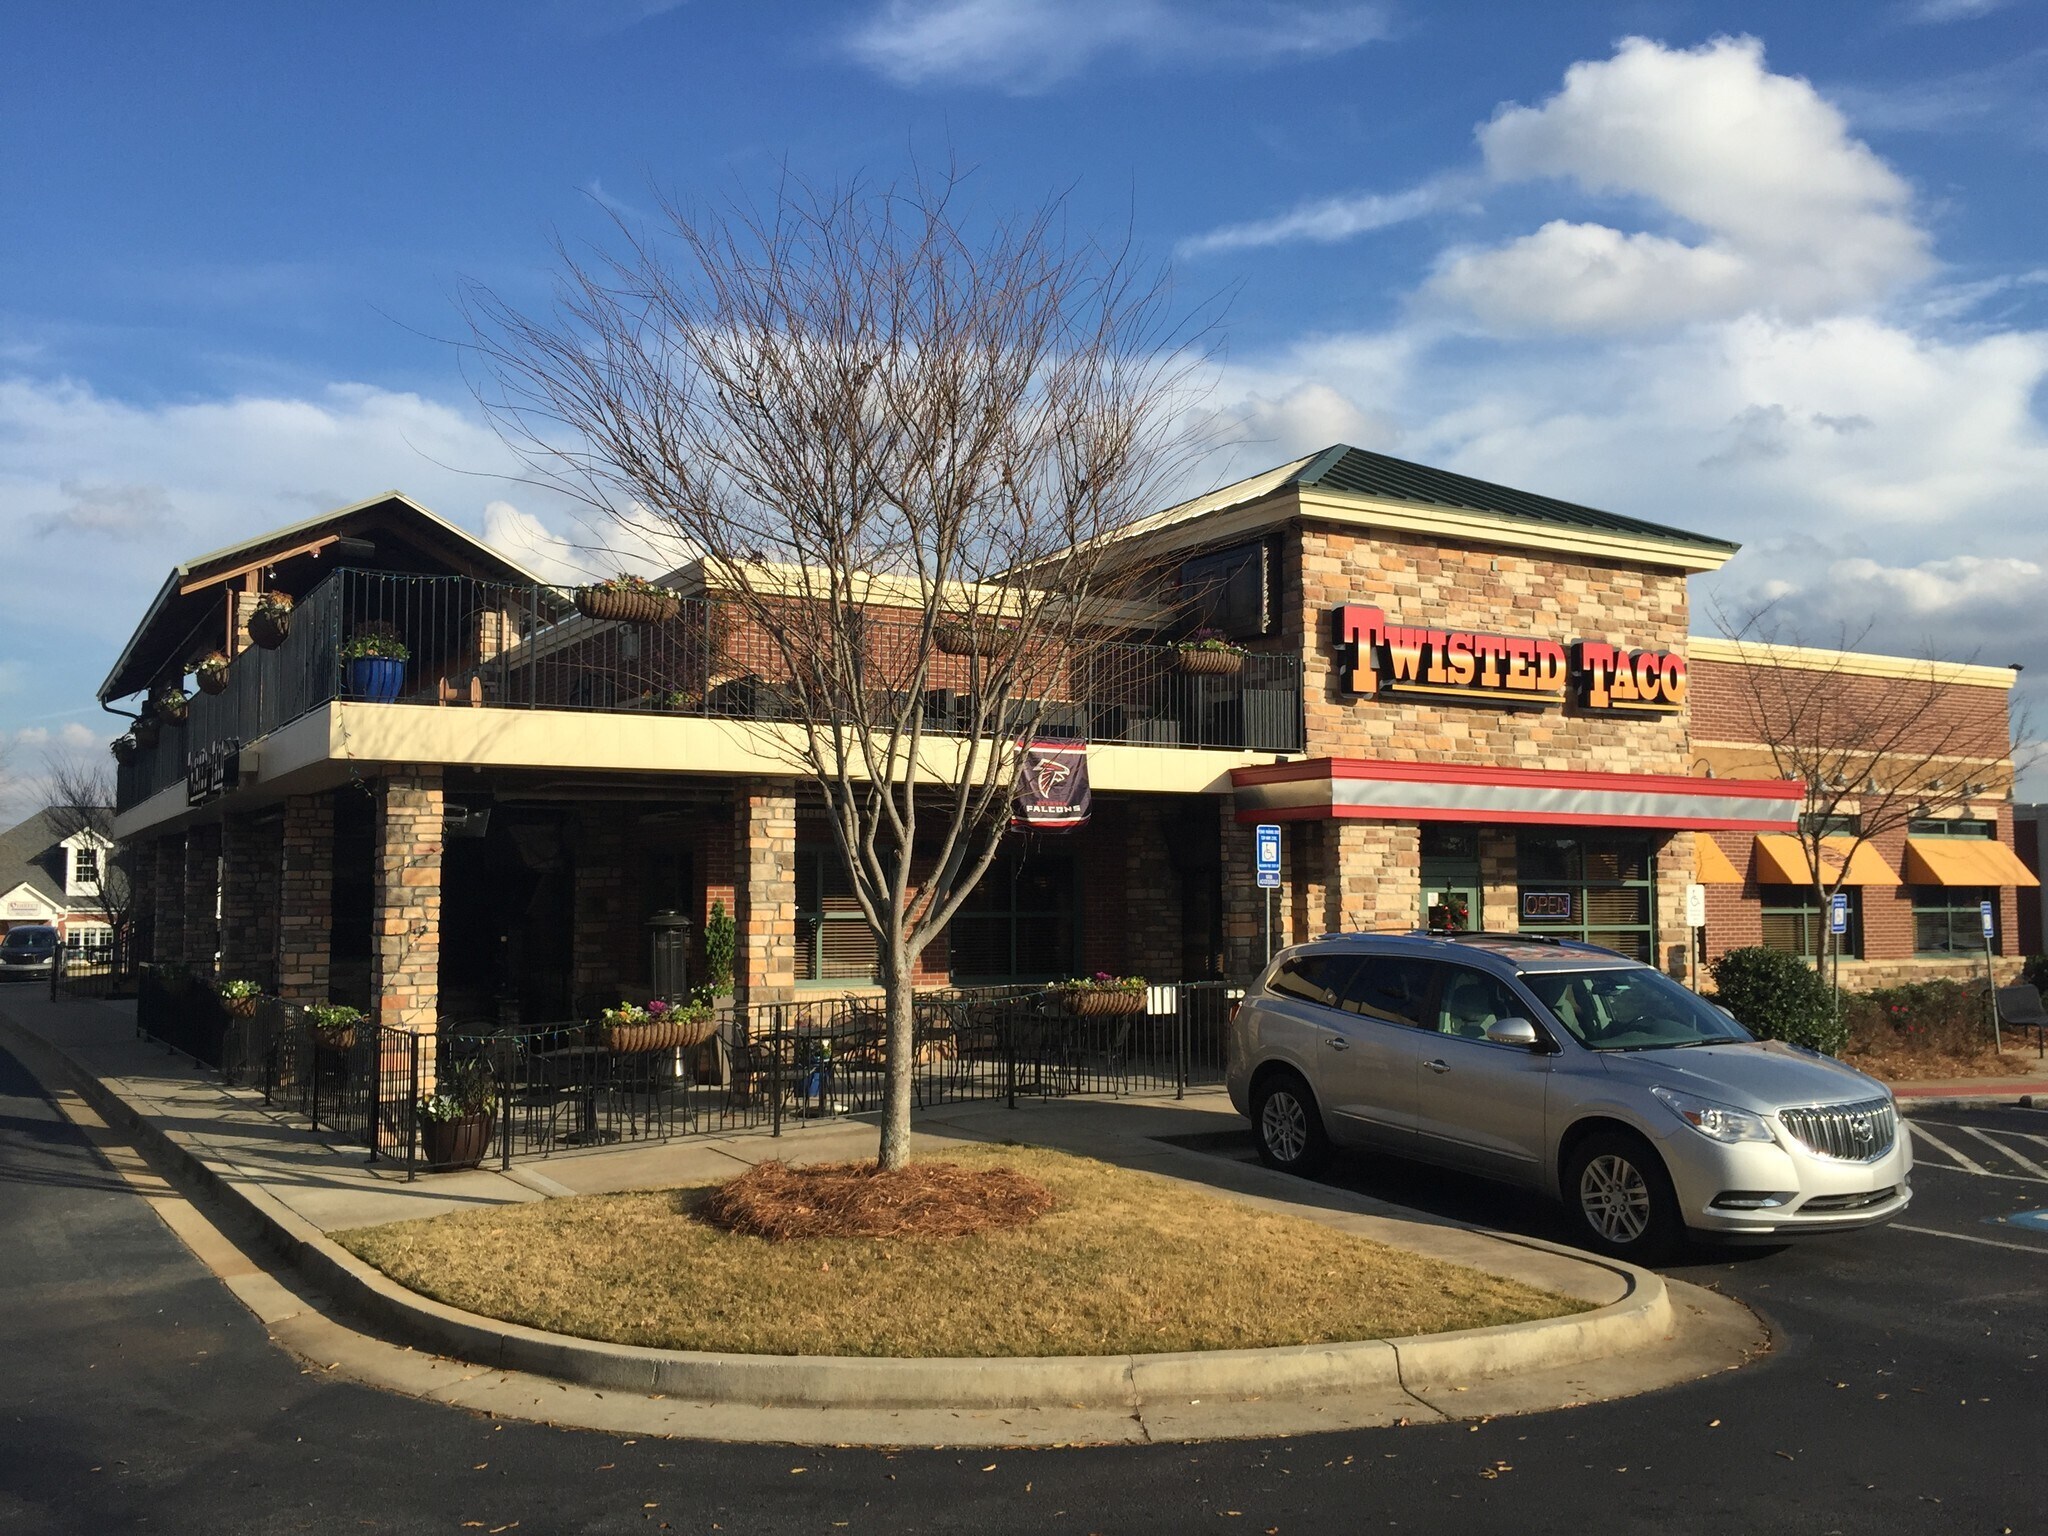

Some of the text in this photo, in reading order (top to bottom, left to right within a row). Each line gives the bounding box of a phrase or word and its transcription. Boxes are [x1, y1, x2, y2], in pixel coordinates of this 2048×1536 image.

[1343, 605, 1686, 708] TWISTED TACO
[1026, 804, 1081, 813] FALCONS
[1526, 896, 1569, 914] OPEN
